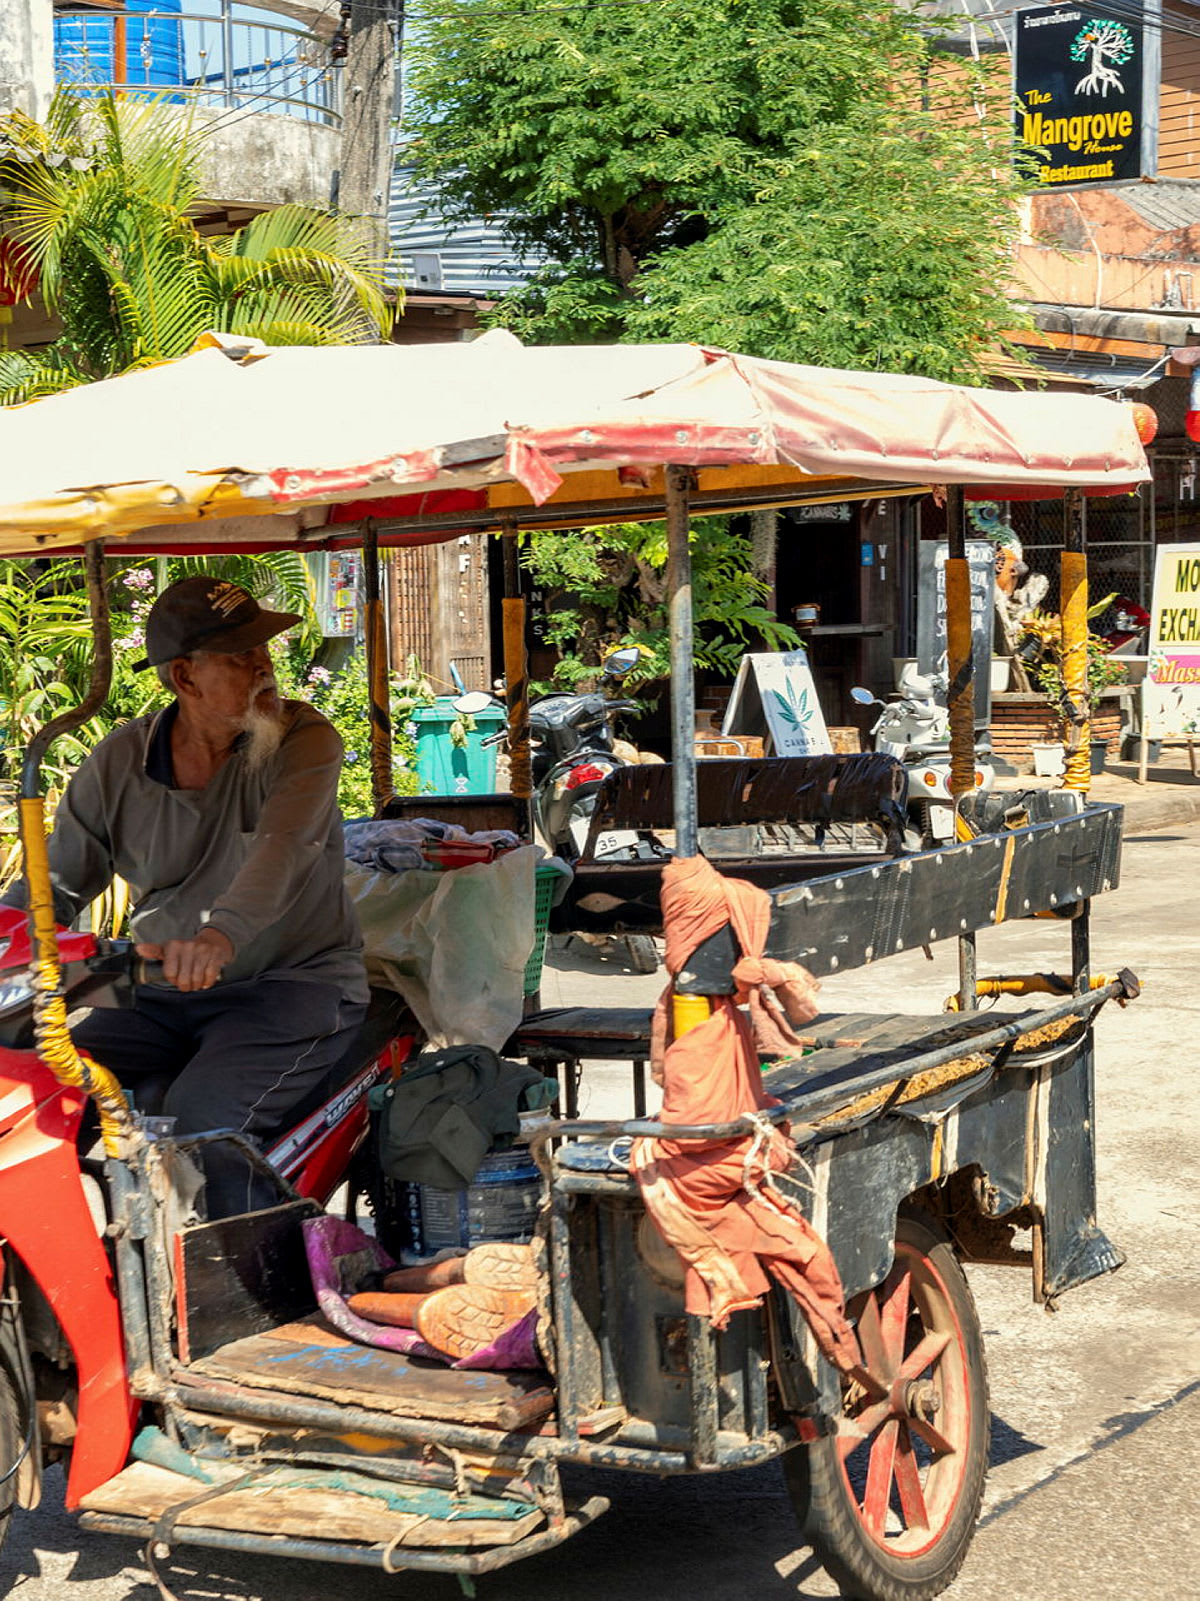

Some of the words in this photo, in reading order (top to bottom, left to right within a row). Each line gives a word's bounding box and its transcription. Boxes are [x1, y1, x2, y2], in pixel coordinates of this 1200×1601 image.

[1024, 89, 1052, 105] The
[1023, 110, 1133, 151] Mangrove
[1083, 140, 1124, 154] House
[1040, 160, 1115, 182] Restaurant
[1159, 608, 1200, 642] EXCH
